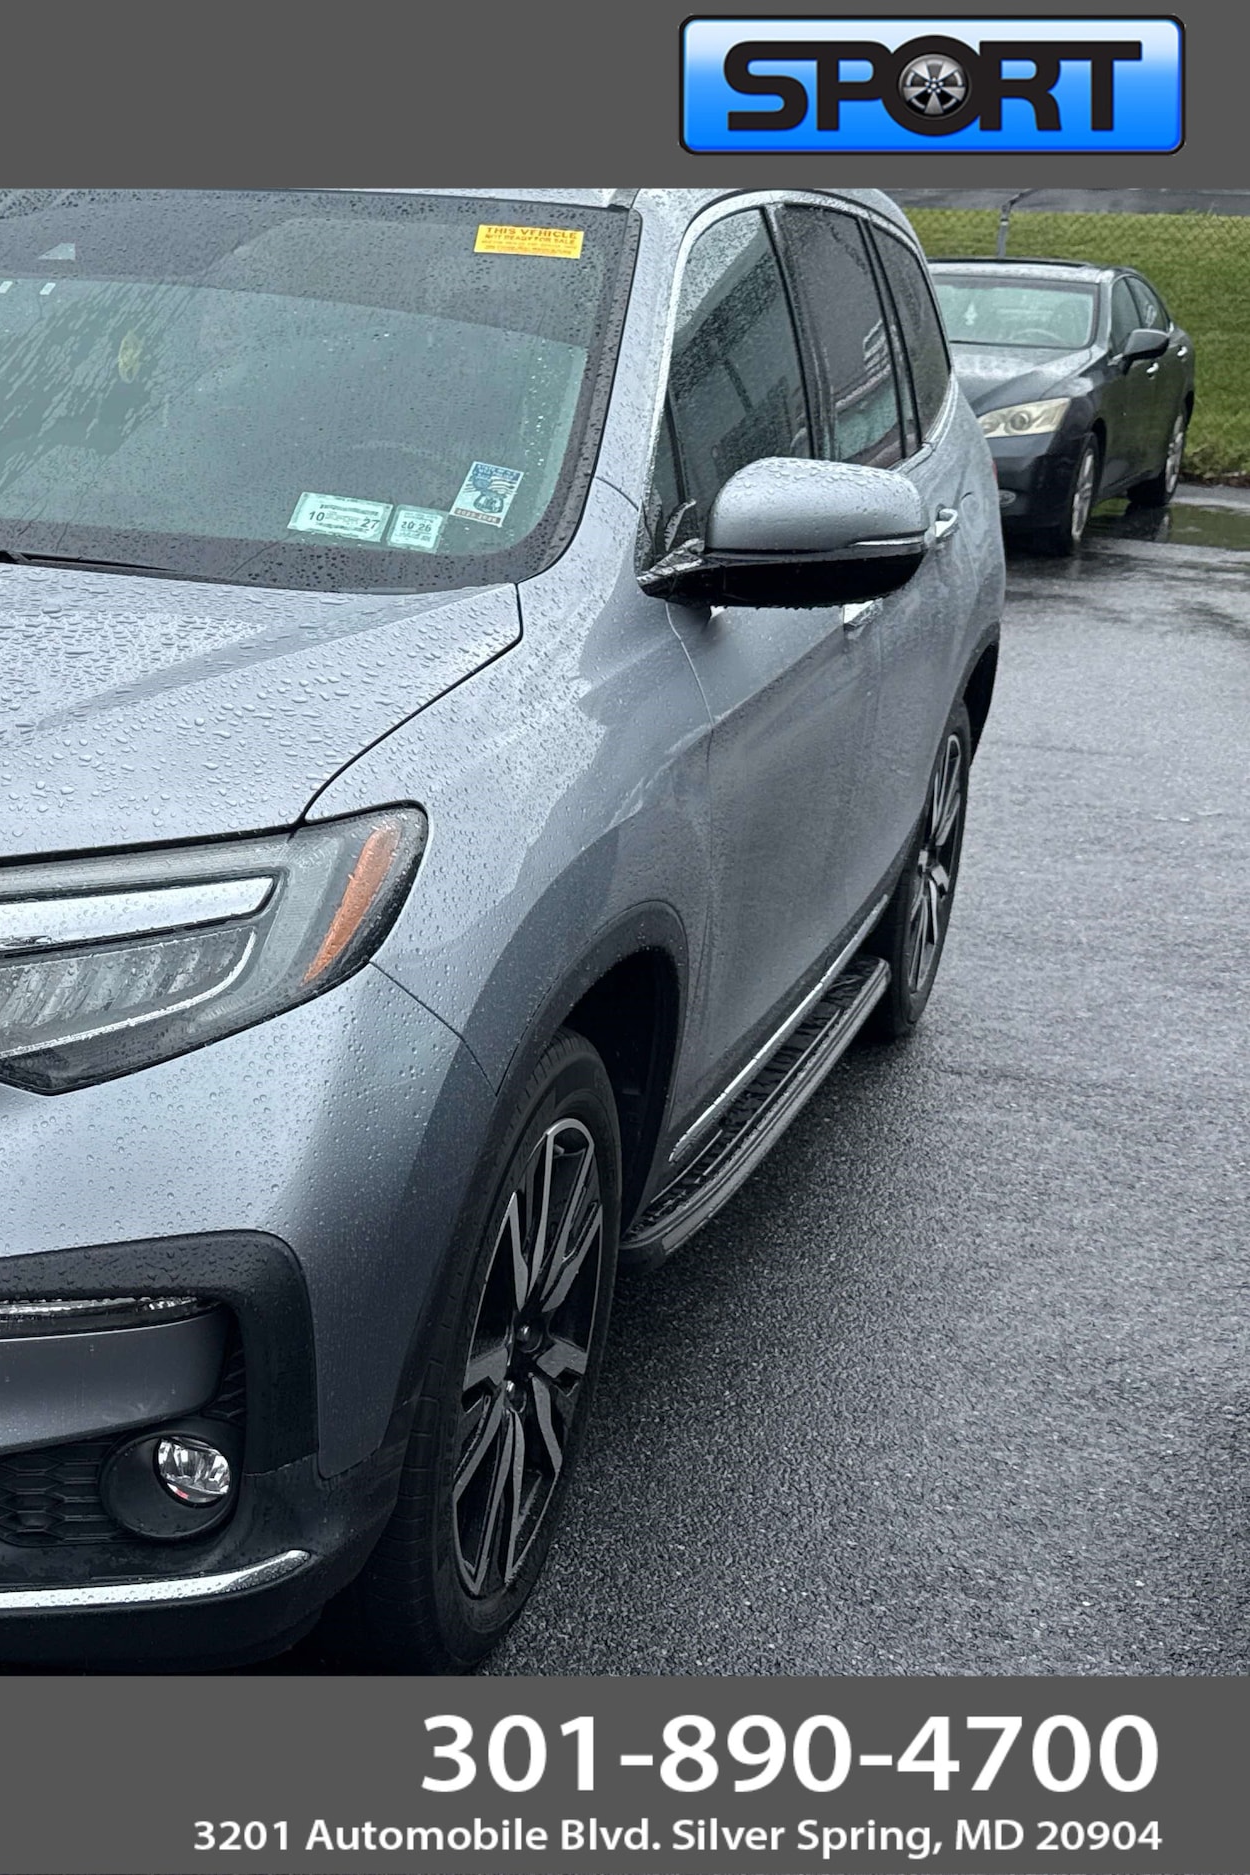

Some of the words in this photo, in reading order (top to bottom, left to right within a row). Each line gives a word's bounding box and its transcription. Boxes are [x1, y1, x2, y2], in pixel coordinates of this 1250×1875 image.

[487, 227, 516, 235] THIS
[520, 229, 578, 239] VEHICLE
[309, 511, 325, 522] 10
[361, 518, 380, 530] 27
[418, 522, 432, 532] 26
